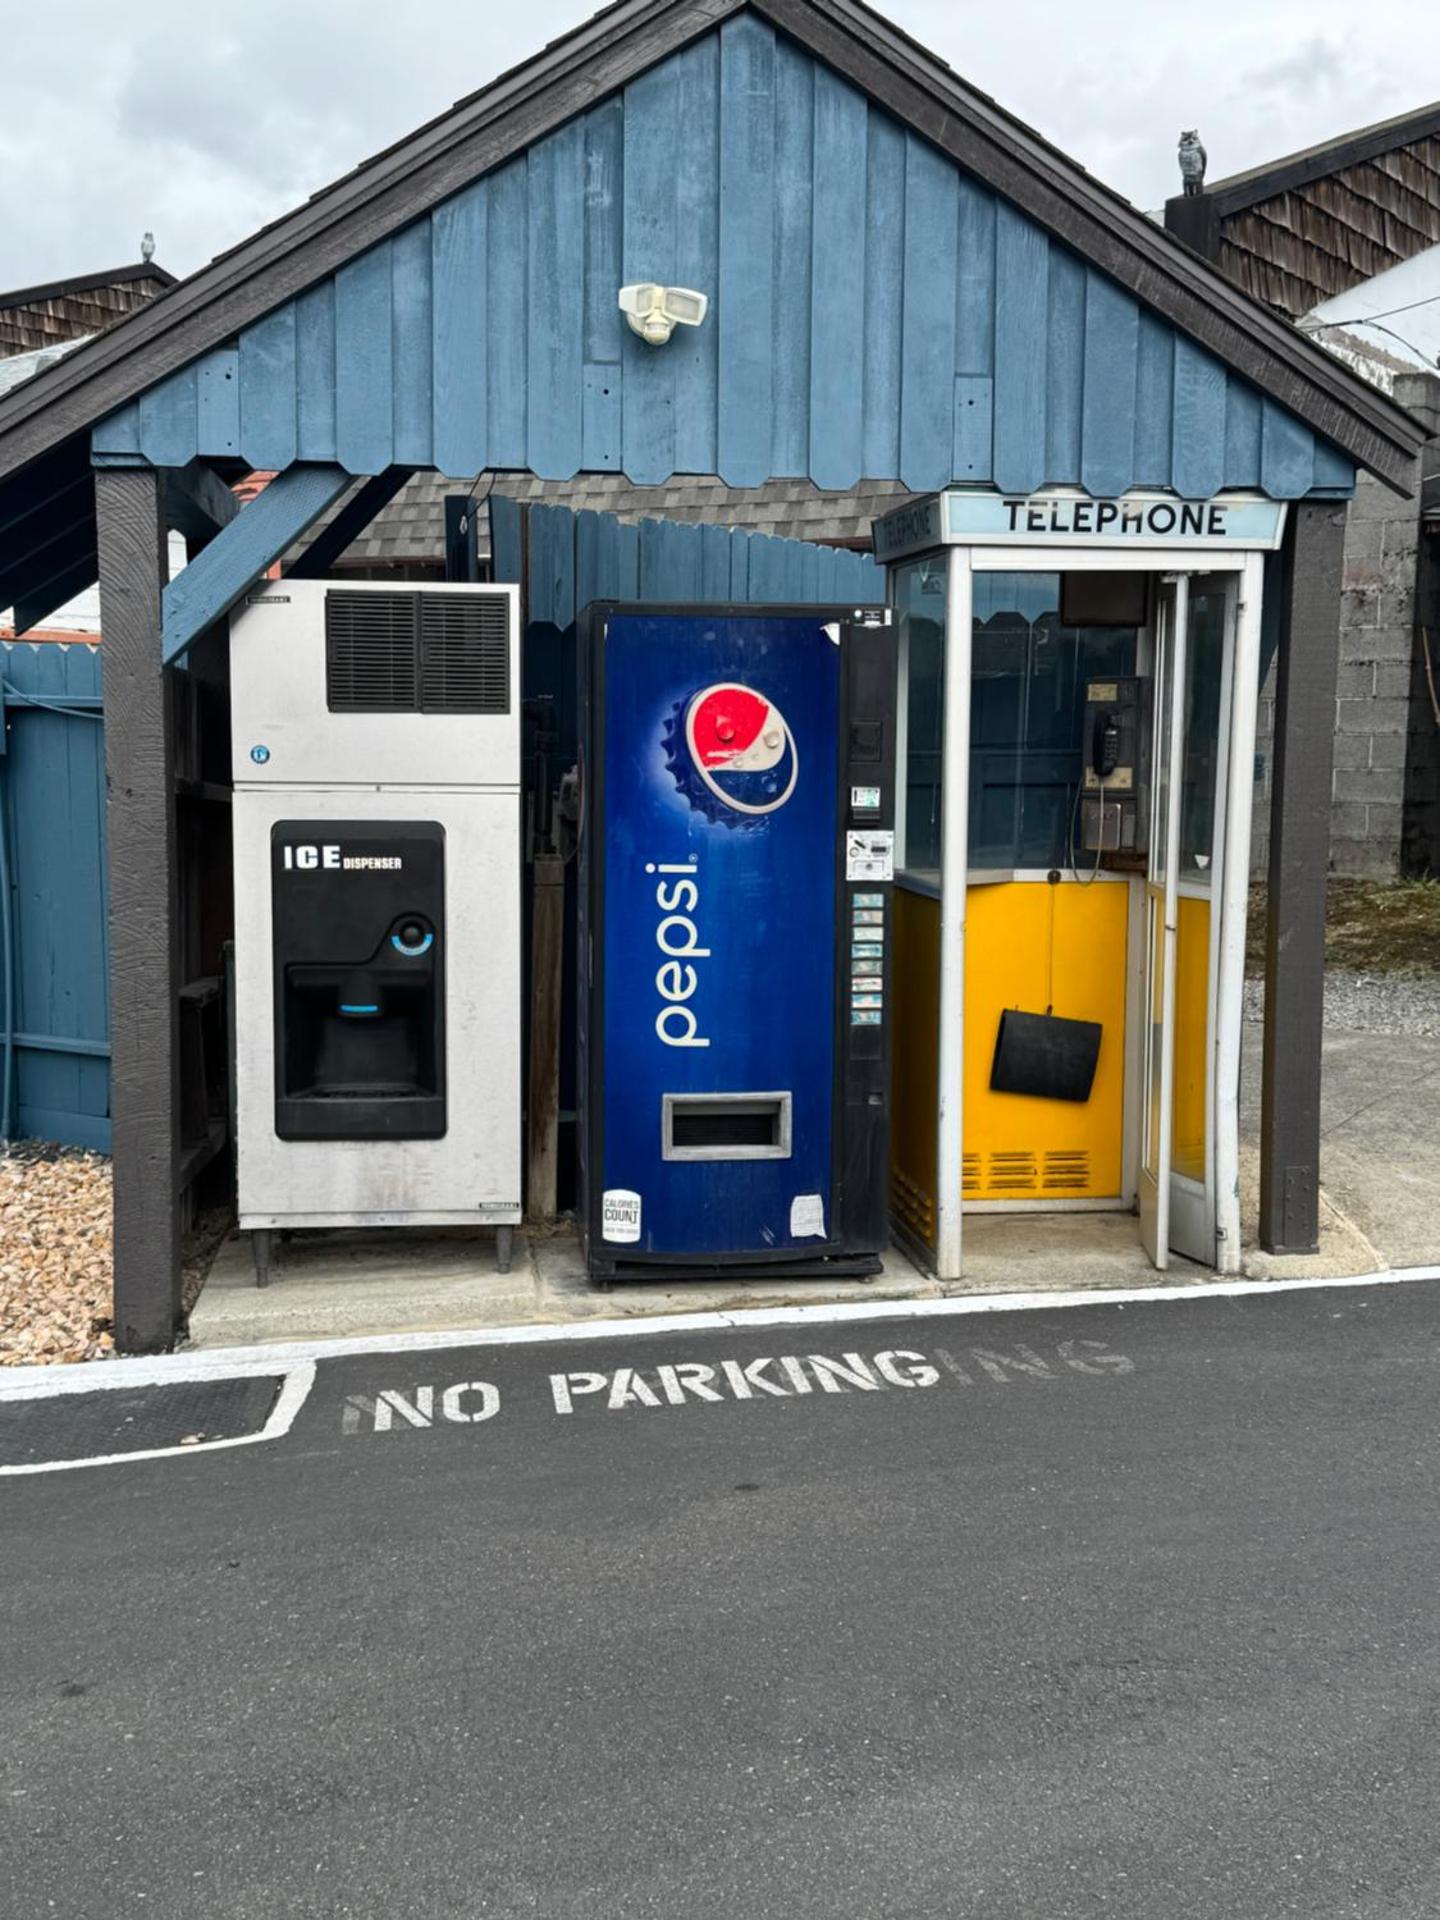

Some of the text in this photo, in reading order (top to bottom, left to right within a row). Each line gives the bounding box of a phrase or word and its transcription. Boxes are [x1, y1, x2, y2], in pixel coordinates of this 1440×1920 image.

[1002, 501, 1228, 535] TELEPHONE
[284, 845, 402, 870] ICE DISPENSER
[645, 863, 711, 1047] pepsi
[604, 1208, 639, 1224] COUNT
[374, 1381, 501, 1432] NO
[548, 1350, 940, 1414] PARKING
